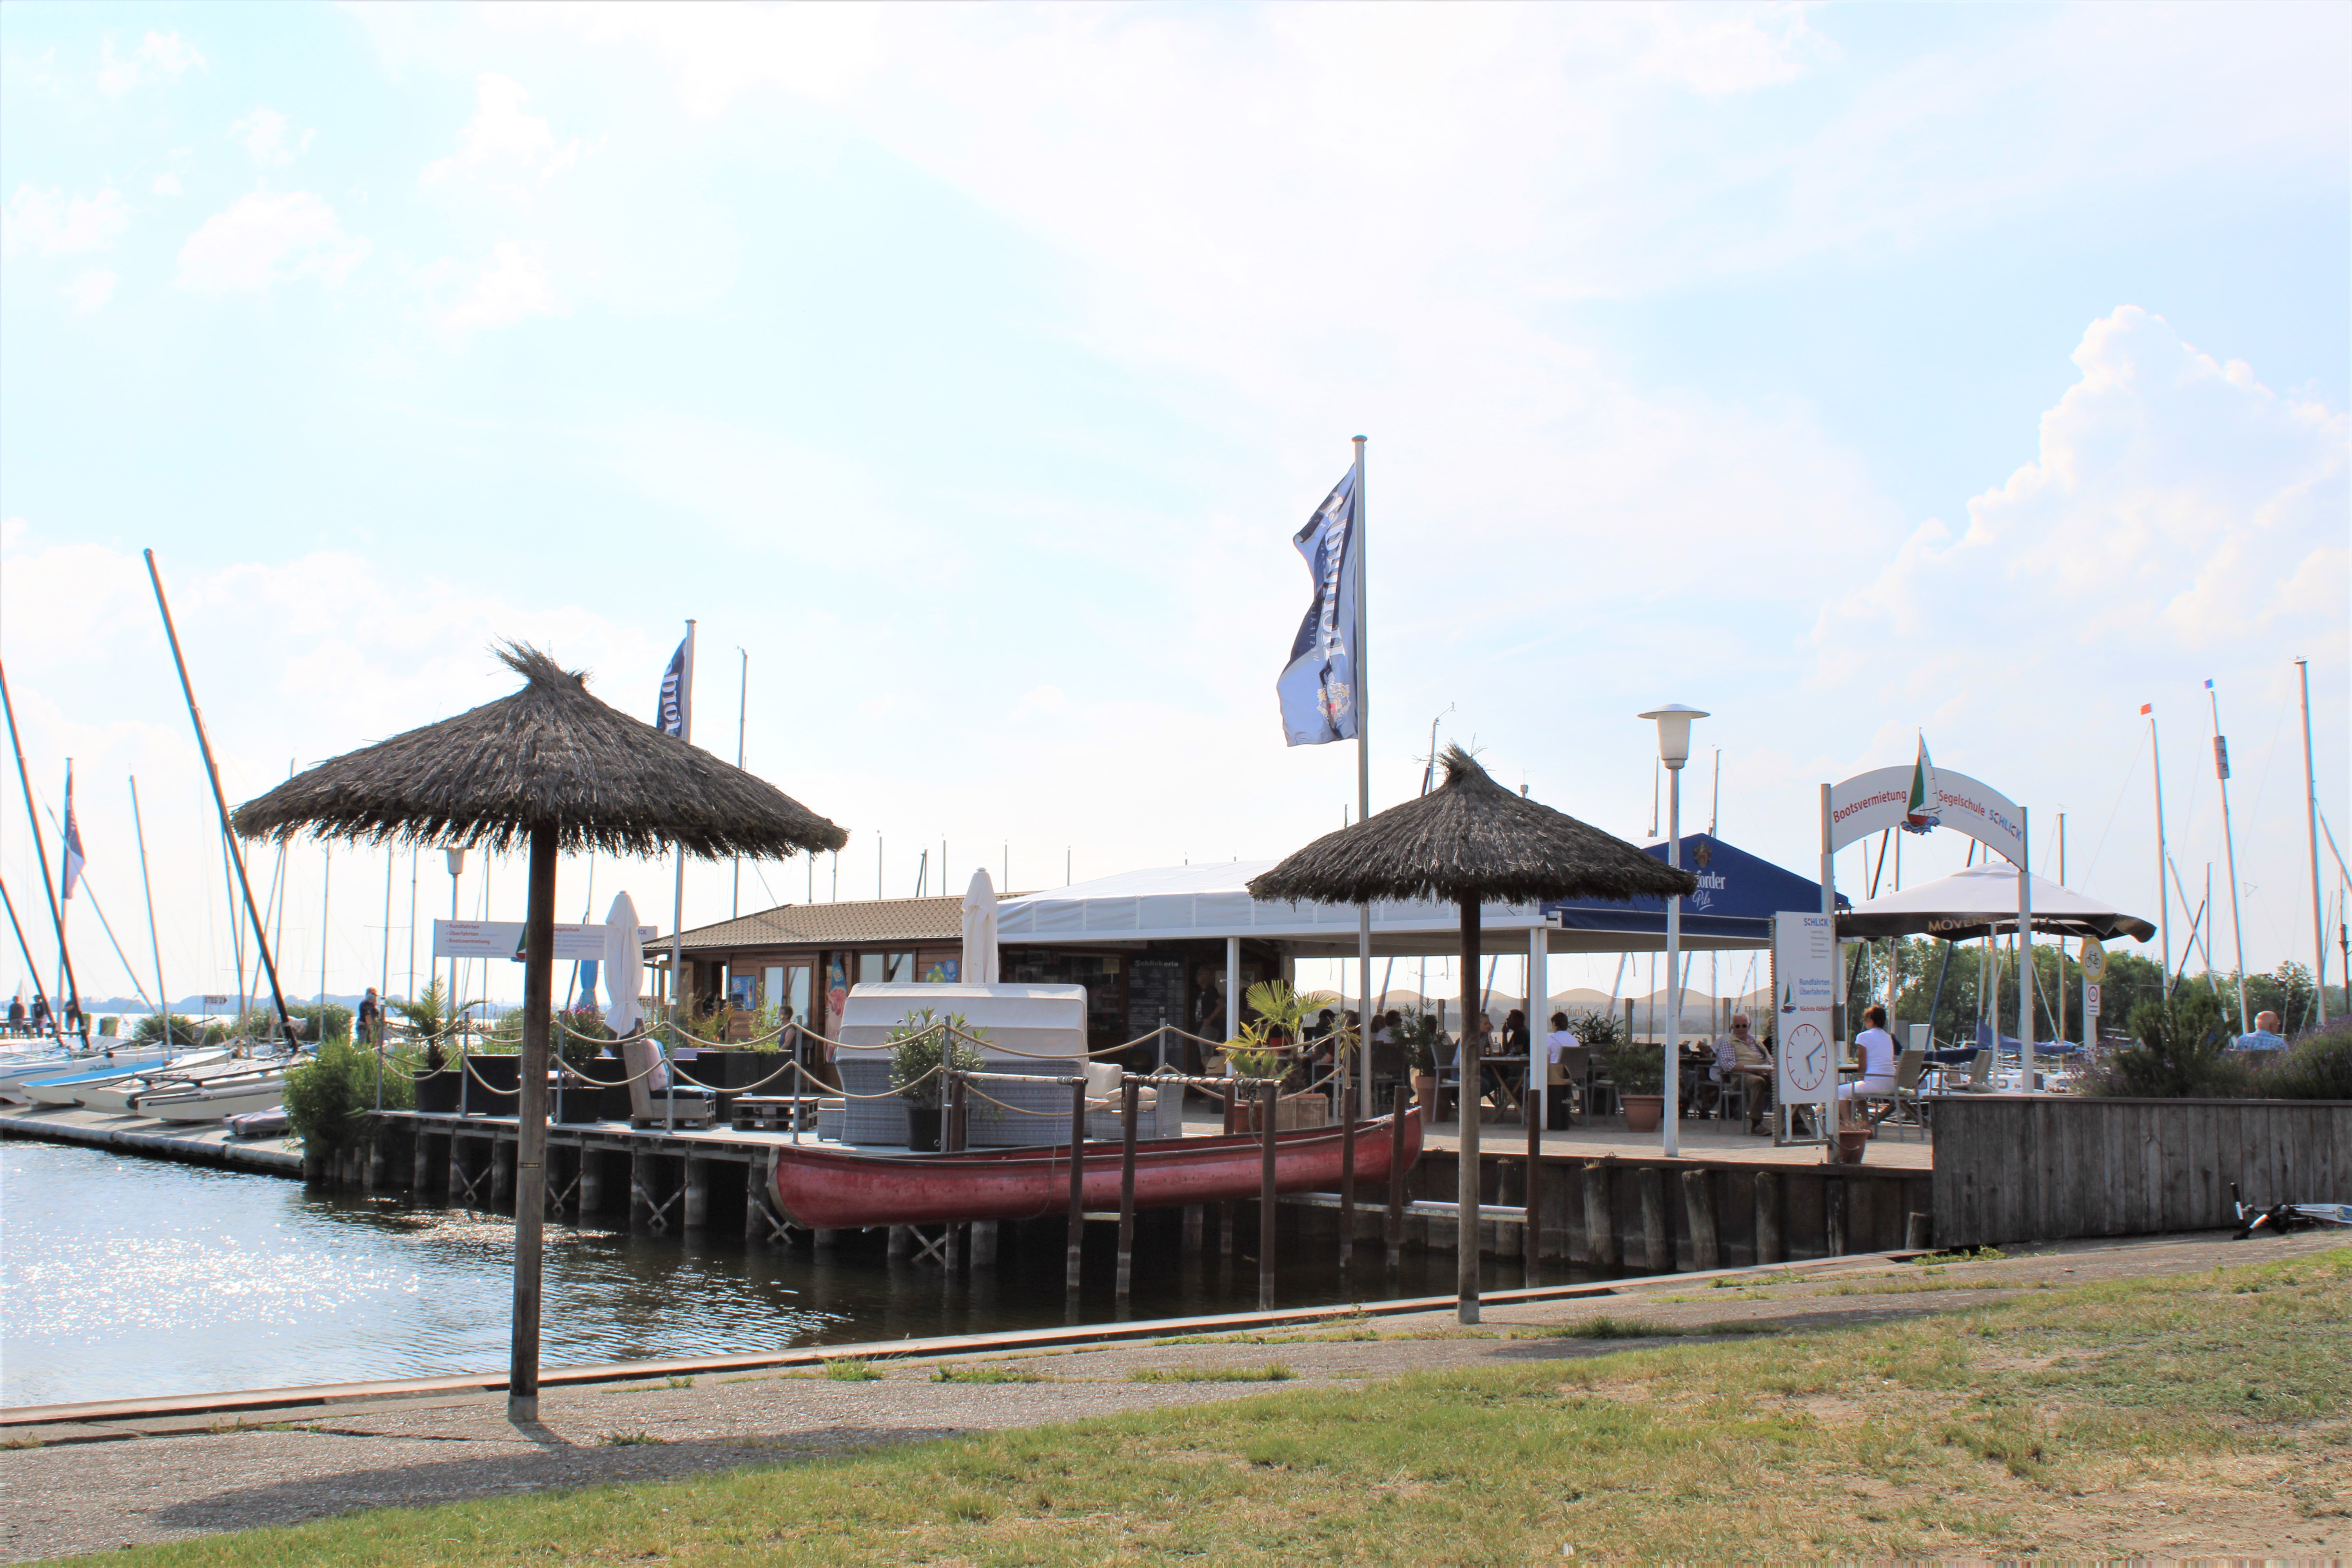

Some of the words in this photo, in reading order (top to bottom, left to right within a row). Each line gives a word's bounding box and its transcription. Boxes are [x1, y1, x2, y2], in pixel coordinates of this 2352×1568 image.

[1833, 790, 1906, 823] Bootsvermietung
[1939, 790, 1985, 816] Segelschule
[1989, 809, 2022, 841] SCHLICK
[1693, 890, 1710, 907] Pils
[1804, 918, 1829, 926] SCHLICK
[1799, 987, 1830, 995] Überfahrten
